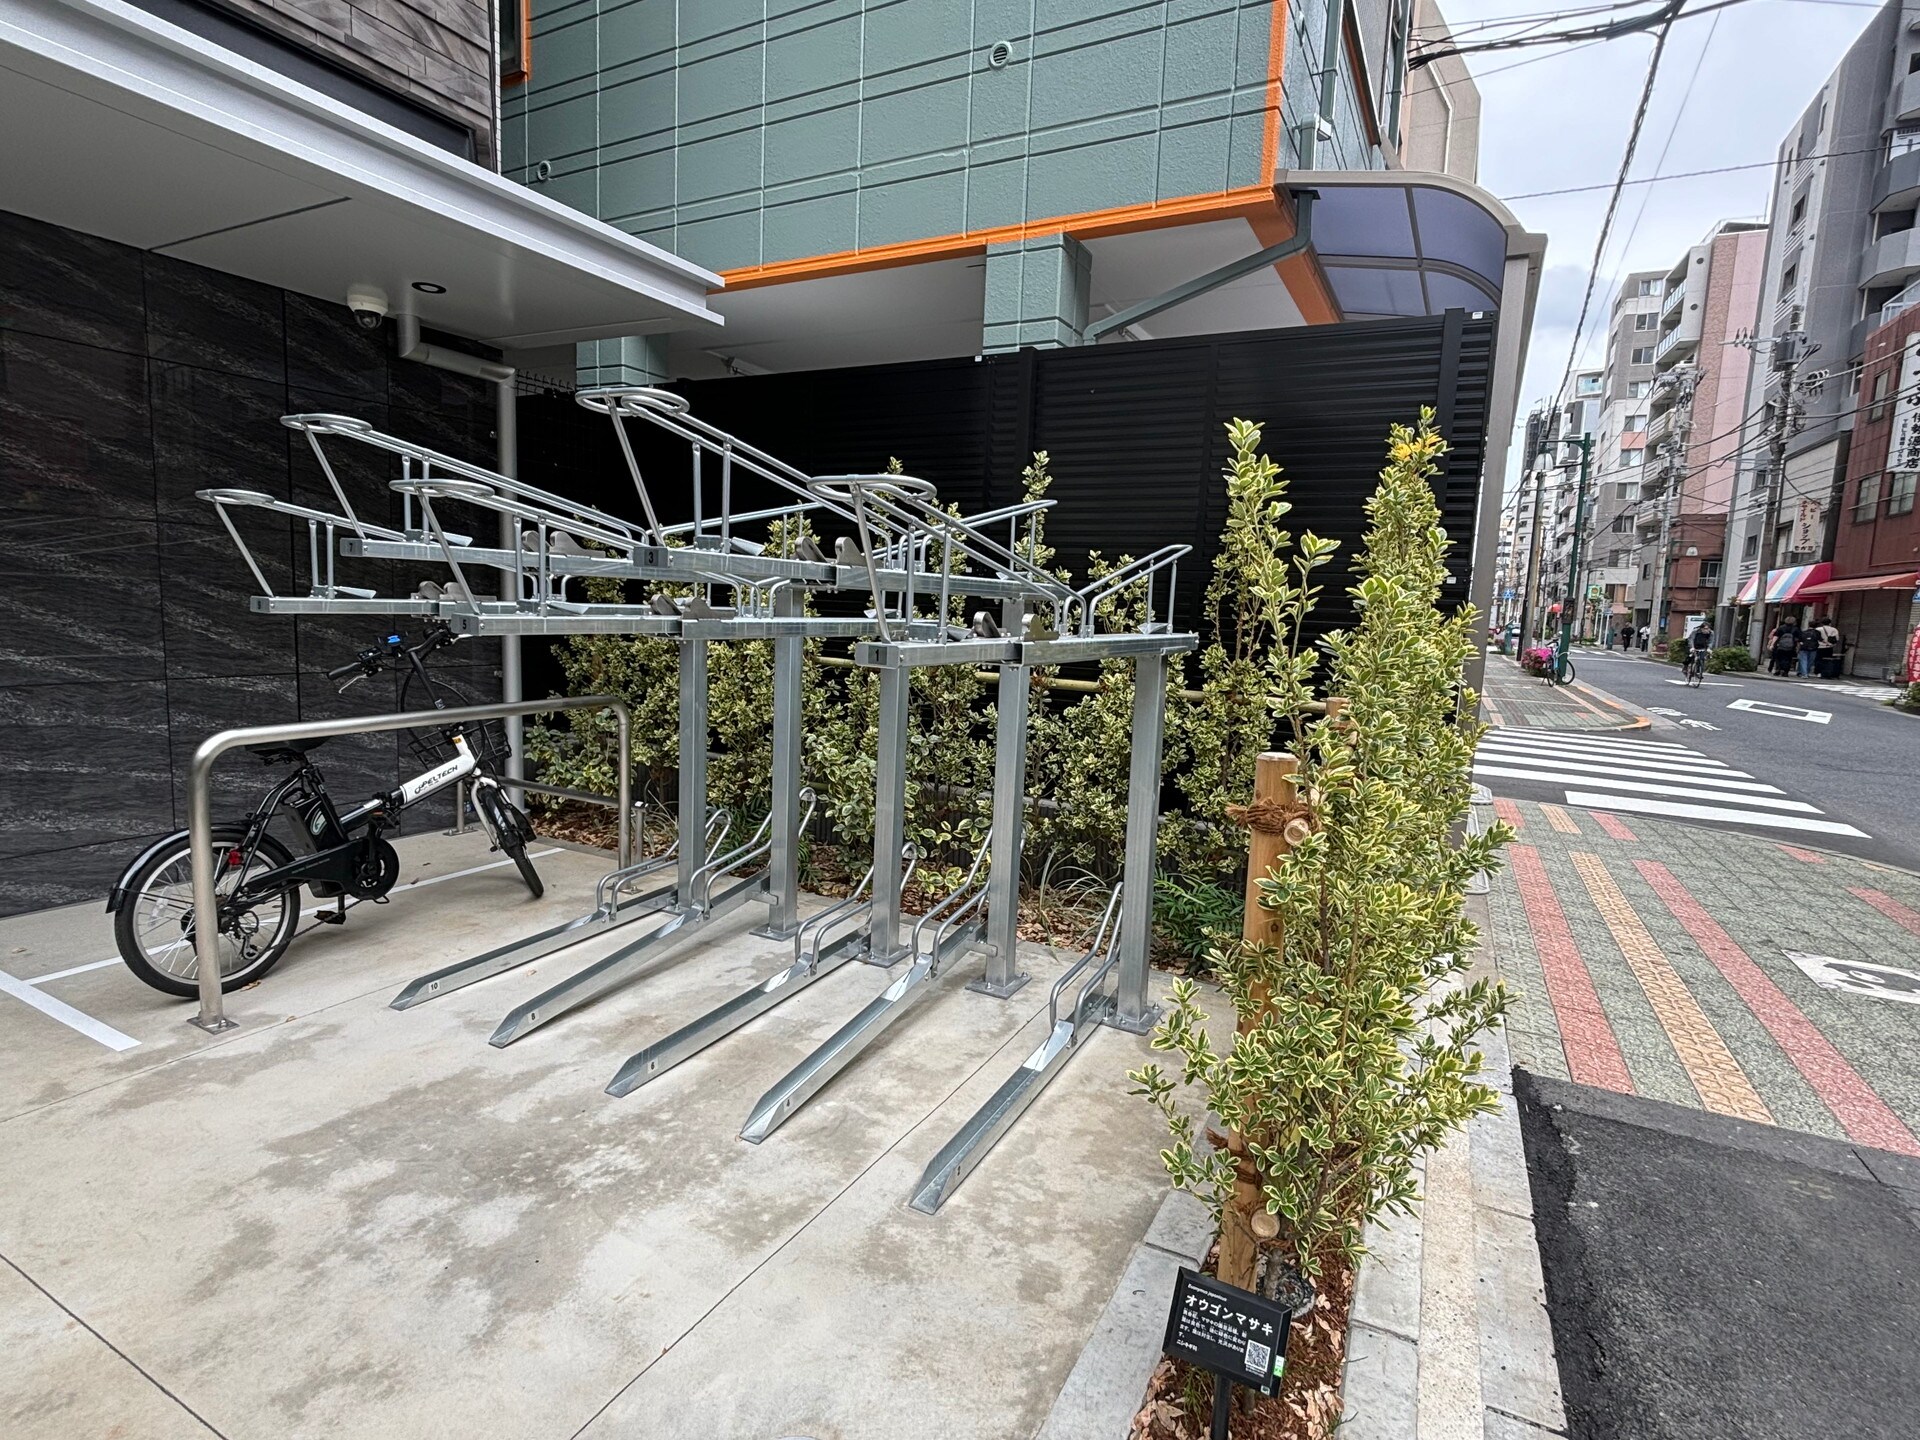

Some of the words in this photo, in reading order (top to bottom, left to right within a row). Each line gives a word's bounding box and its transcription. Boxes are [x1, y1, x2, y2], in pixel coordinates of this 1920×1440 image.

[648, 551, 654, 564] 3
[462, 619, 467, 630] 5
[874, 648, 880, 662] 1
[430, 982, 439, 991] 10
[1185, 1294, 1274, 1337] オウゴンマサキ
